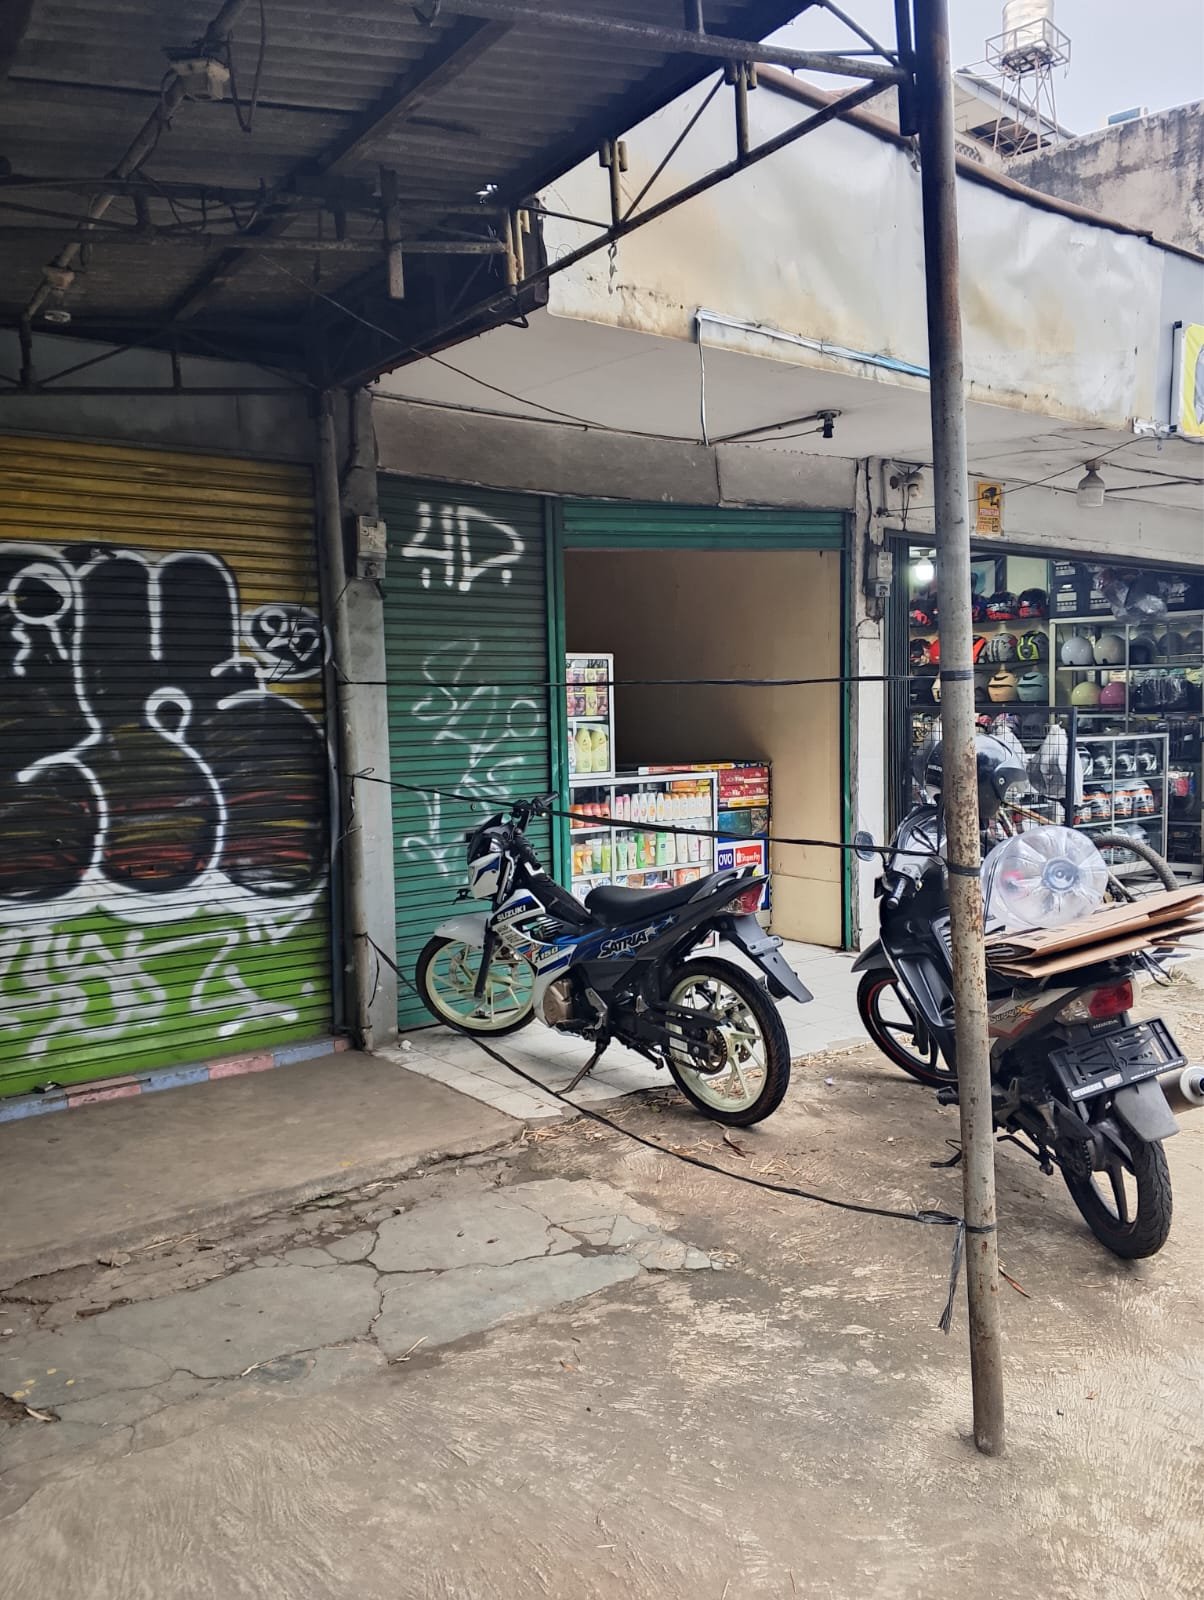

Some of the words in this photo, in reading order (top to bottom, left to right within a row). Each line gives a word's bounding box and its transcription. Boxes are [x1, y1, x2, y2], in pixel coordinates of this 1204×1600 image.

[718, 853, 733, 866] OVO
[496, 904, 526, 922] SUZUKI
[597, 930, 649, 958] SATRIA
